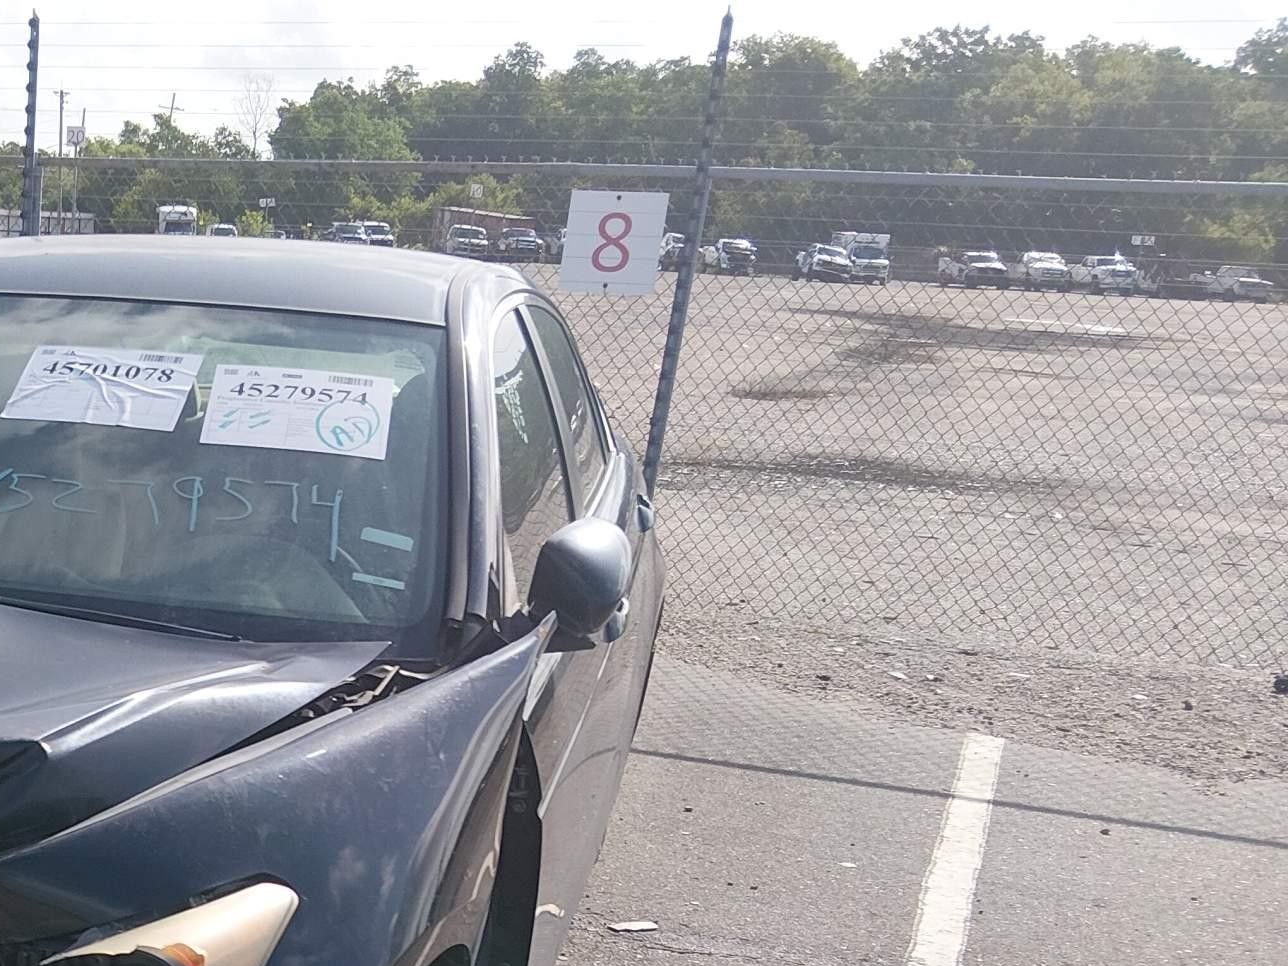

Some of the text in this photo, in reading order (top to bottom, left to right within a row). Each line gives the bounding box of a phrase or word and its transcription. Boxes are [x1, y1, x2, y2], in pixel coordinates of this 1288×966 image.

[592, 212, 632, 273] 8
[42, 360, 175, 383] 45701078
[229, 382, 369, 406] 45279574
